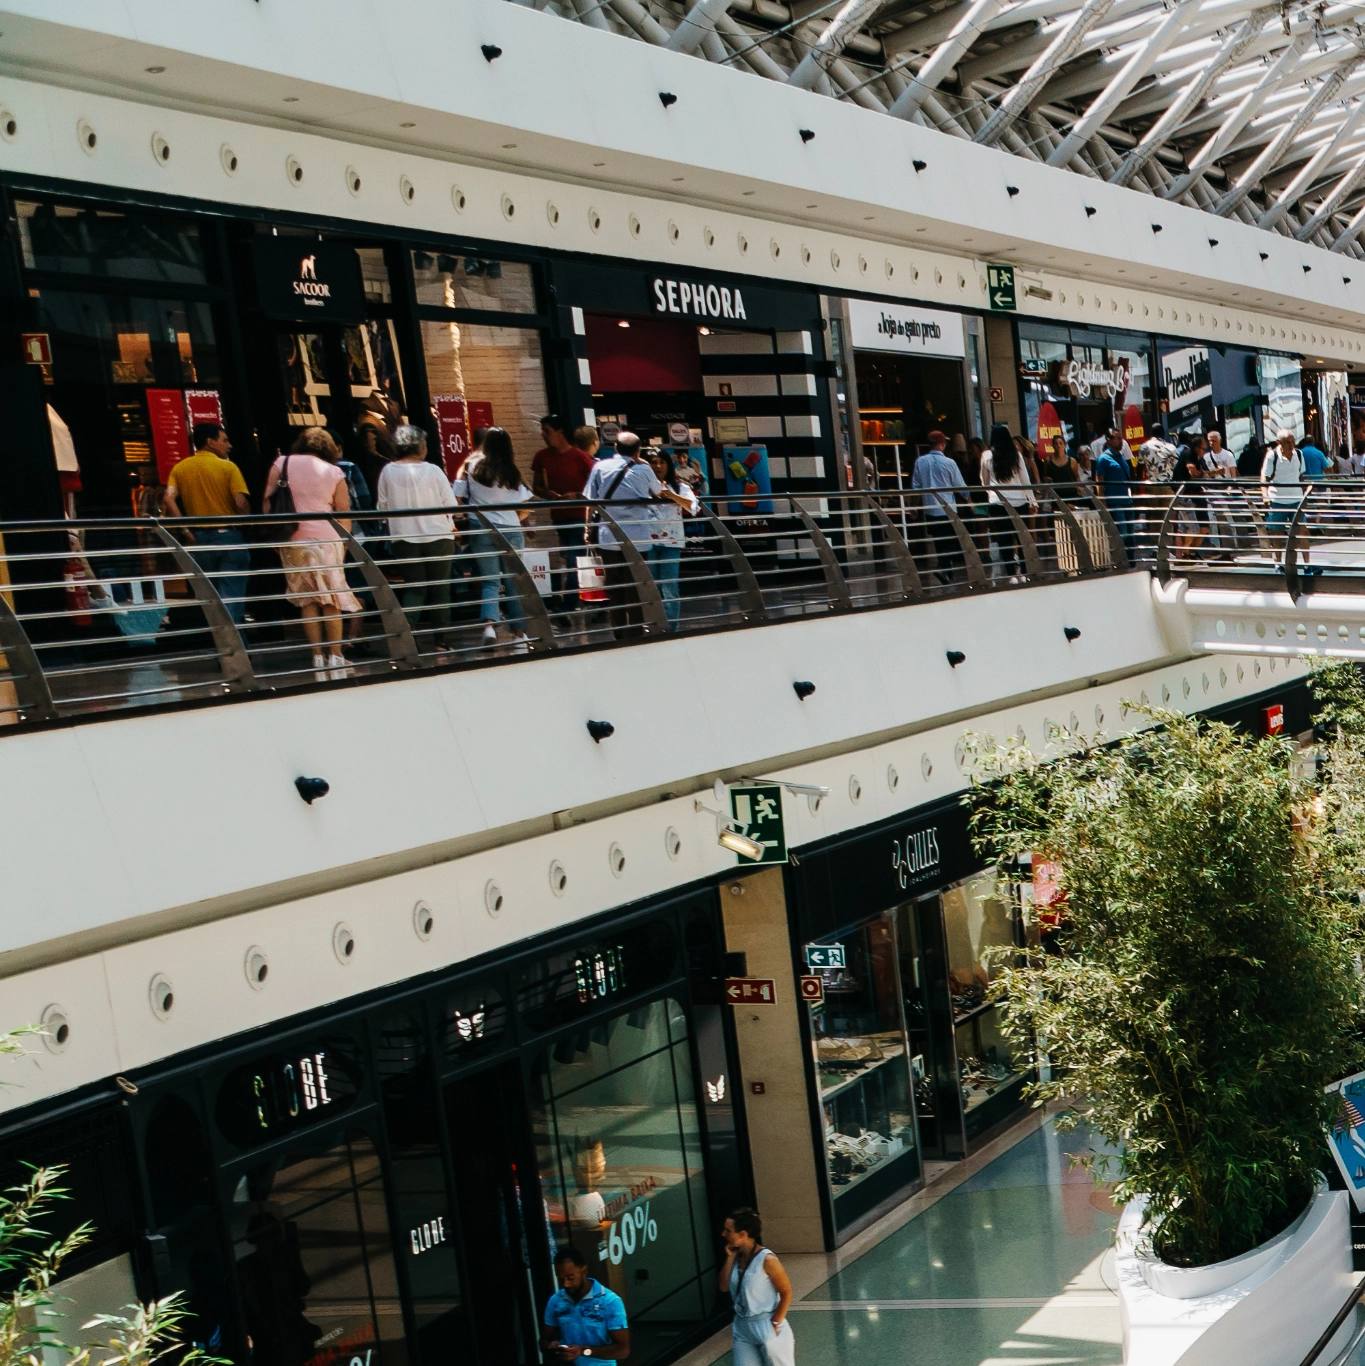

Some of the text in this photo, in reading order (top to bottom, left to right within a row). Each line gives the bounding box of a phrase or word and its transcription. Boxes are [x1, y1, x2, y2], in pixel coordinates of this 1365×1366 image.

[293, 281, 331, 297] SACOOR
[654, 279, 747, 320] SEPHORA
[736, 518, 769, 527] OFERTA
[906, 827, 940, 873] GILLES
[411, 1216, 446, 1255] GLOBE
